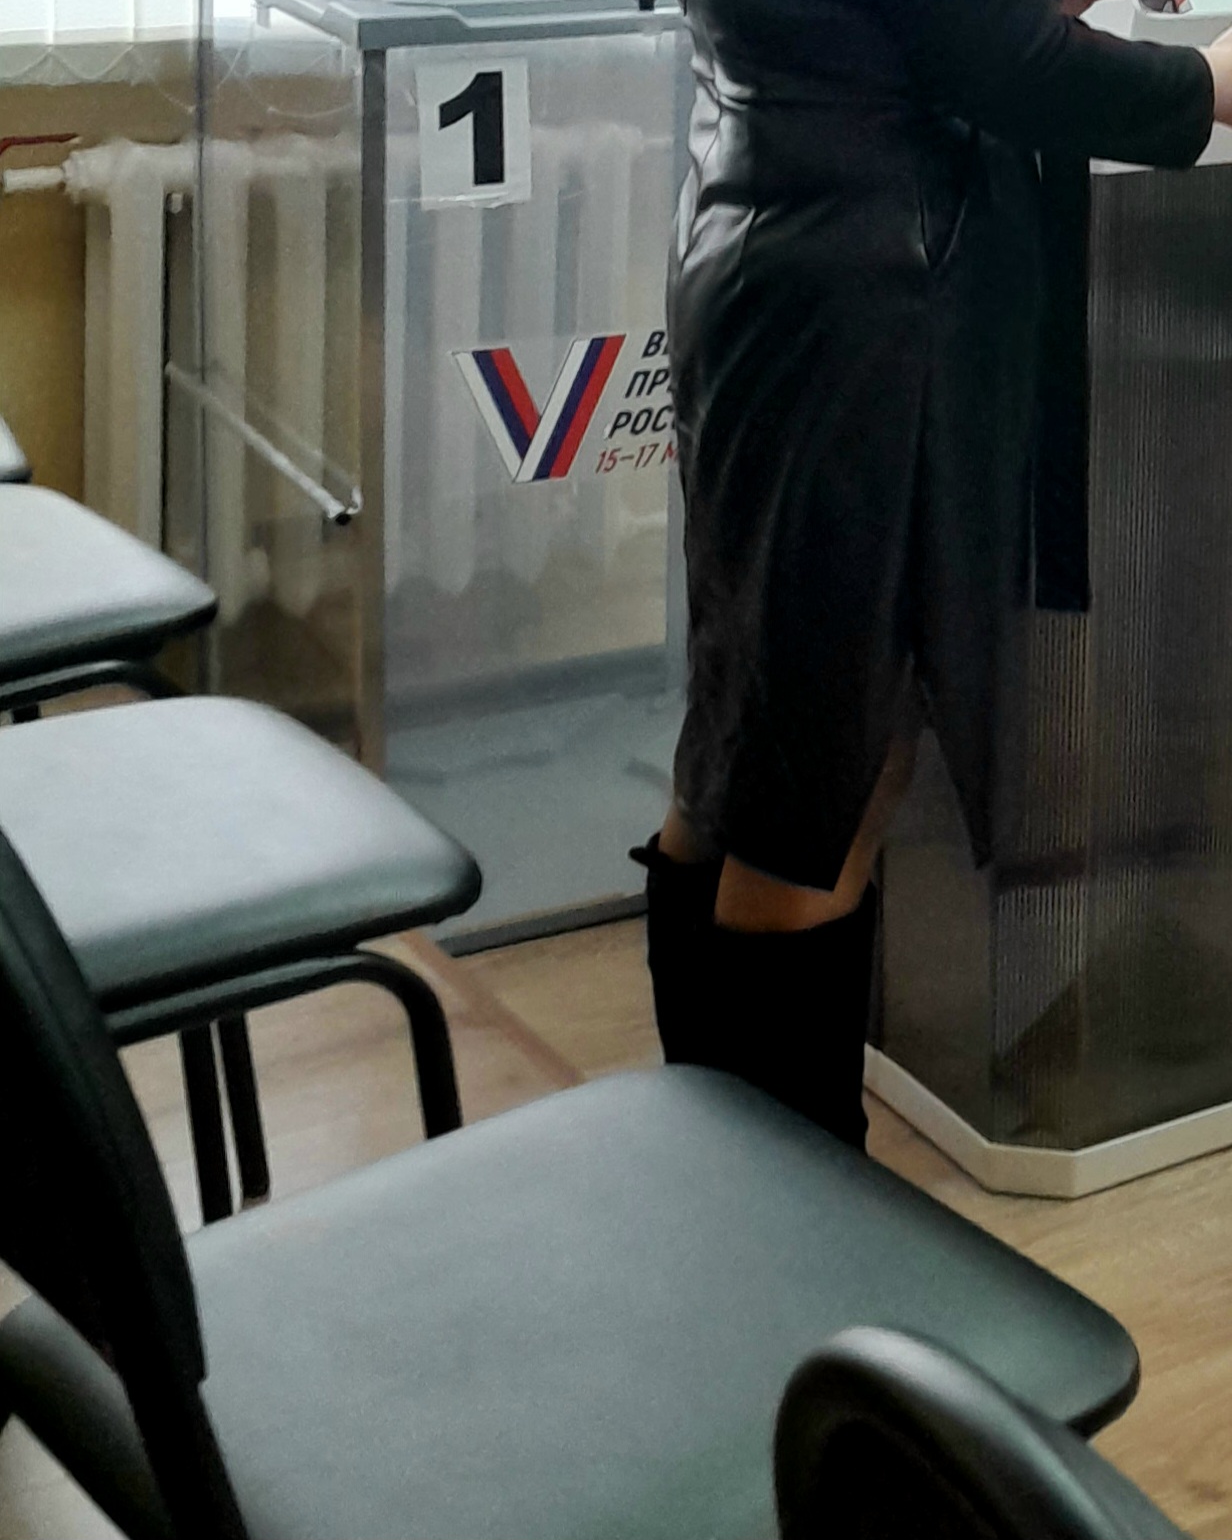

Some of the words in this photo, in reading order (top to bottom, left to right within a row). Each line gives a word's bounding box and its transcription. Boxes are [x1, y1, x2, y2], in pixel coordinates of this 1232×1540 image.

[438, 70, 506, 186] 1
[625, 367, 676, 399] ПР
[608, 404, 677, 440] РОС
[596, 441, 660, 475] 15-17
